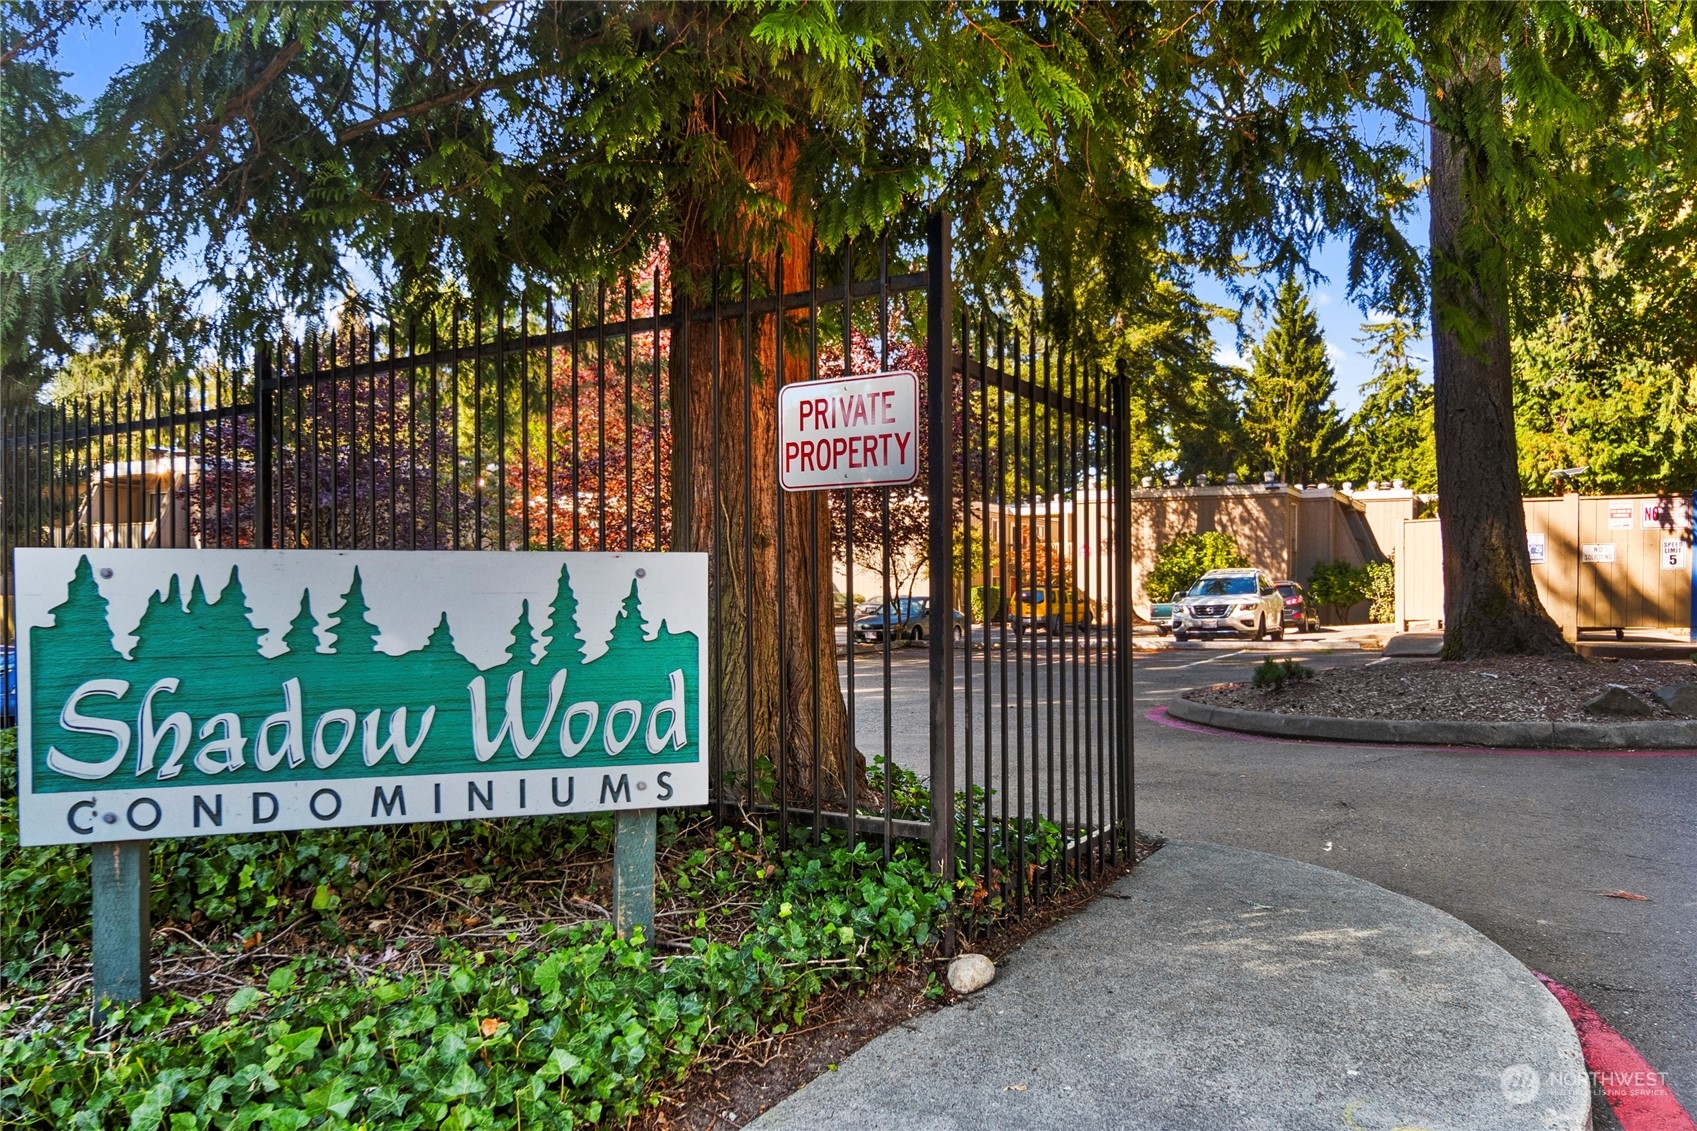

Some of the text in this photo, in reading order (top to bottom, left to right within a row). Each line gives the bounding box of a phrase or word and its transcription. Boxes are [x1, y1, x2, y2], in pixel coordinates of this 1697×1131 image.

[799, 390, 896, 432] PRIVATE
[785, 431, 911, 473] PROPERTY
[1669, 554, 1677, 565] 5
[46, 668, 688, 781] Shadow Wood
[66, 770, 675, 835] CONDOMINIUMS
